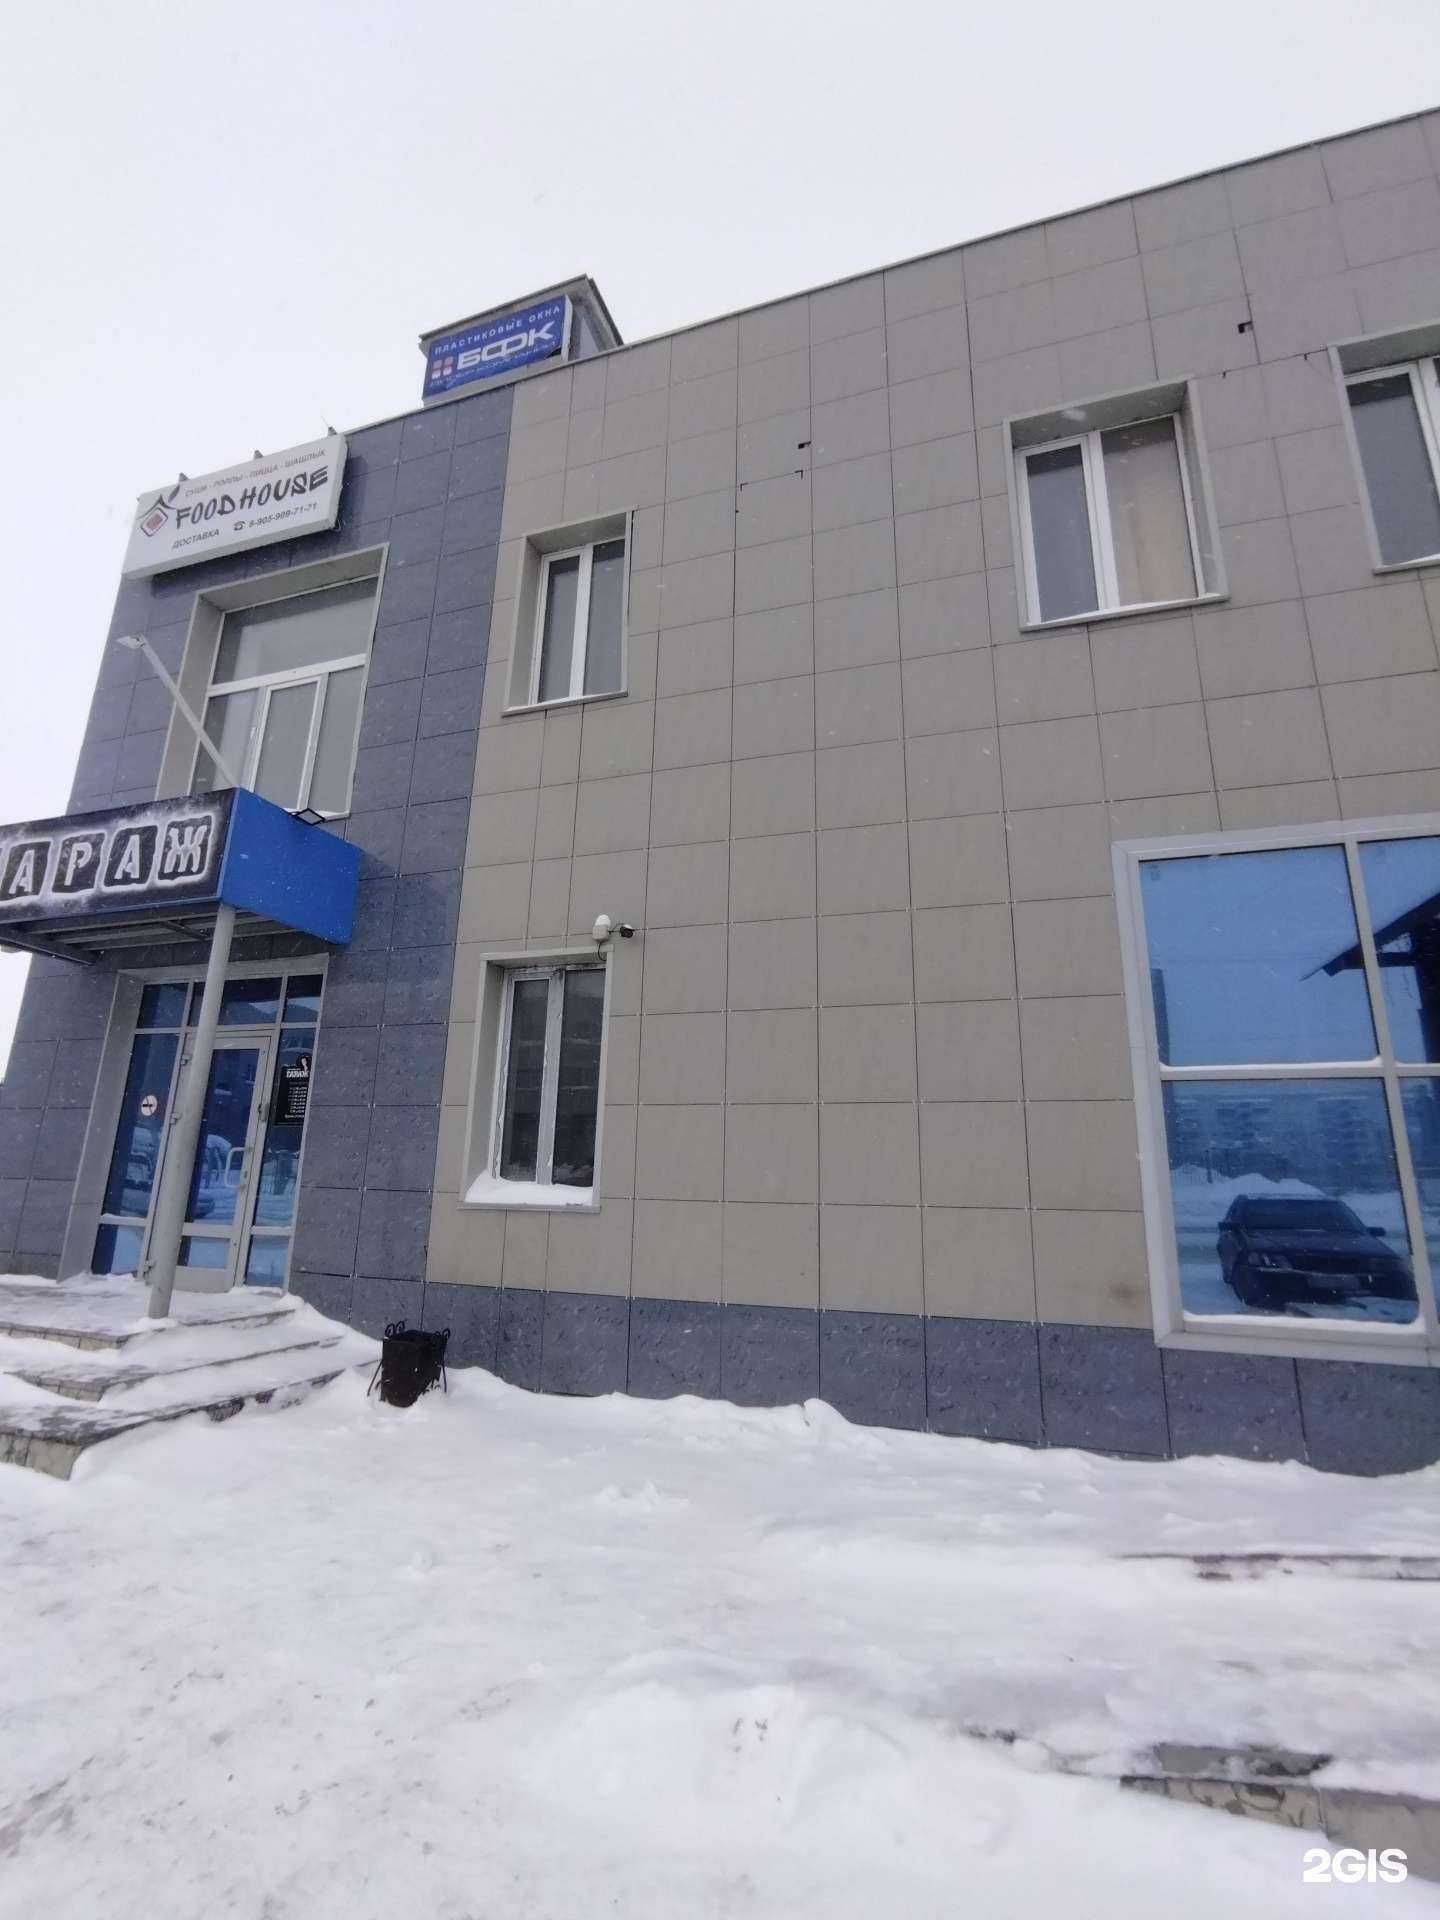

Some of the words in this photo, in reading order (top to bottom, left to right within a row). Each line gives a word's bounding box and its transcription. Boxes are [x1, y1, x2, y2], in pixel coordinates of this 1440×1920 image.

[434, 321, 523, 355] ПЛАСТИКОВЫЕ
[528, 305, 561, 323] ОКНА
[456, 320, 555, 370] БФК
[171, 528, 220, 551] ДОСТАВКА
